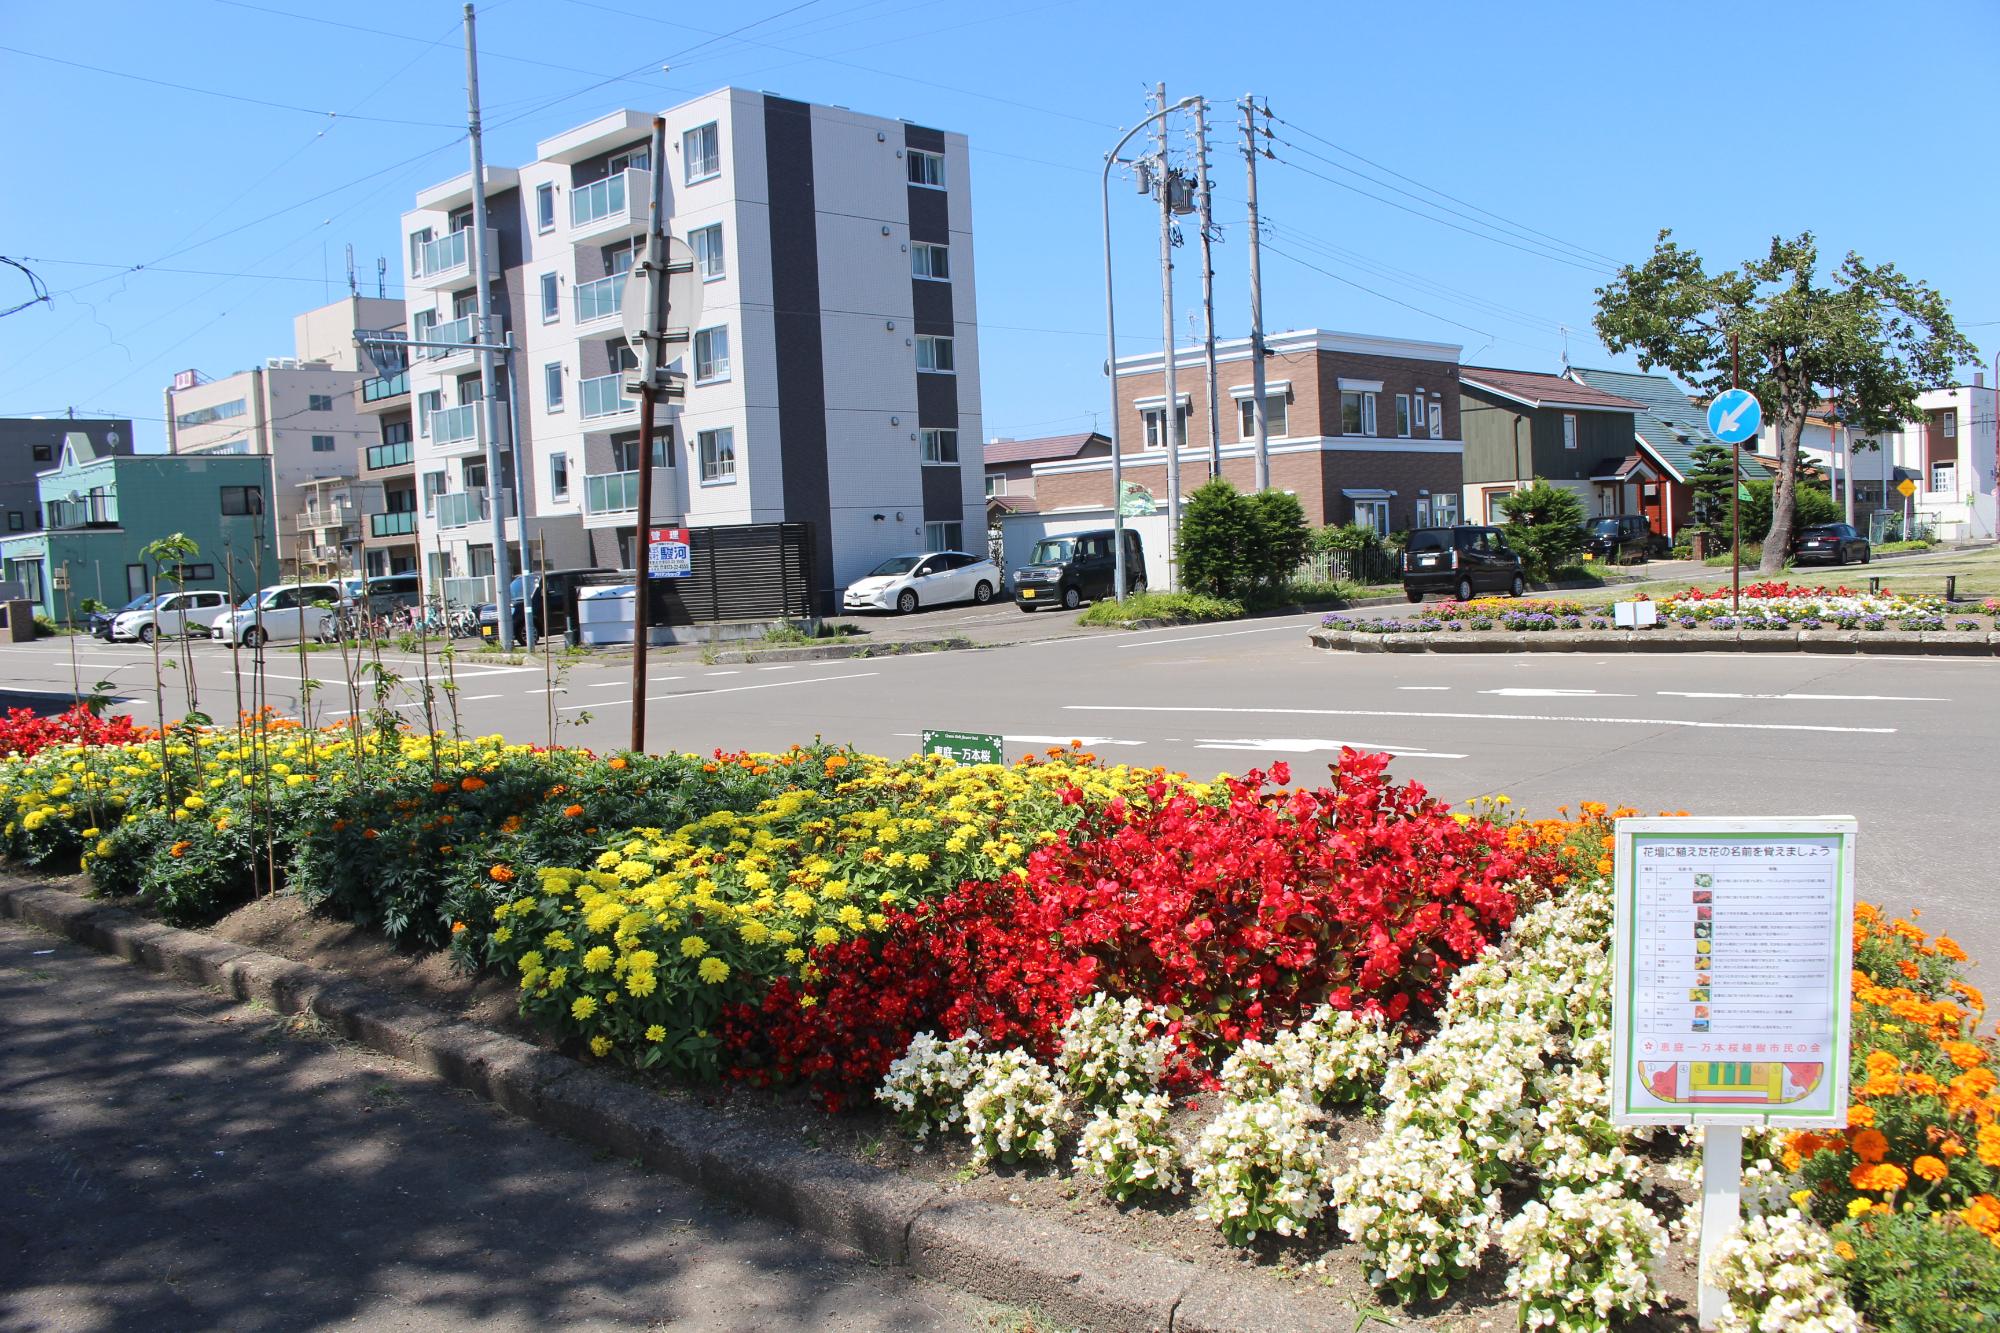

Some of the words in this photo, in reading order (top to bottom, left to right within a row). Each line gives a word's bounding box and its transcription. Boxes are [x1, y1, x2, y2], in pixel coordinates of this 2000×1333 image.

[661, 546, 686, 560] 駿河
[1643, 846, 1830, 858] 花壇に植えた花の名前を覚えましょう
[1660, 1041, 1821, 1053] 恵庭一万本桜植樹市民の会
